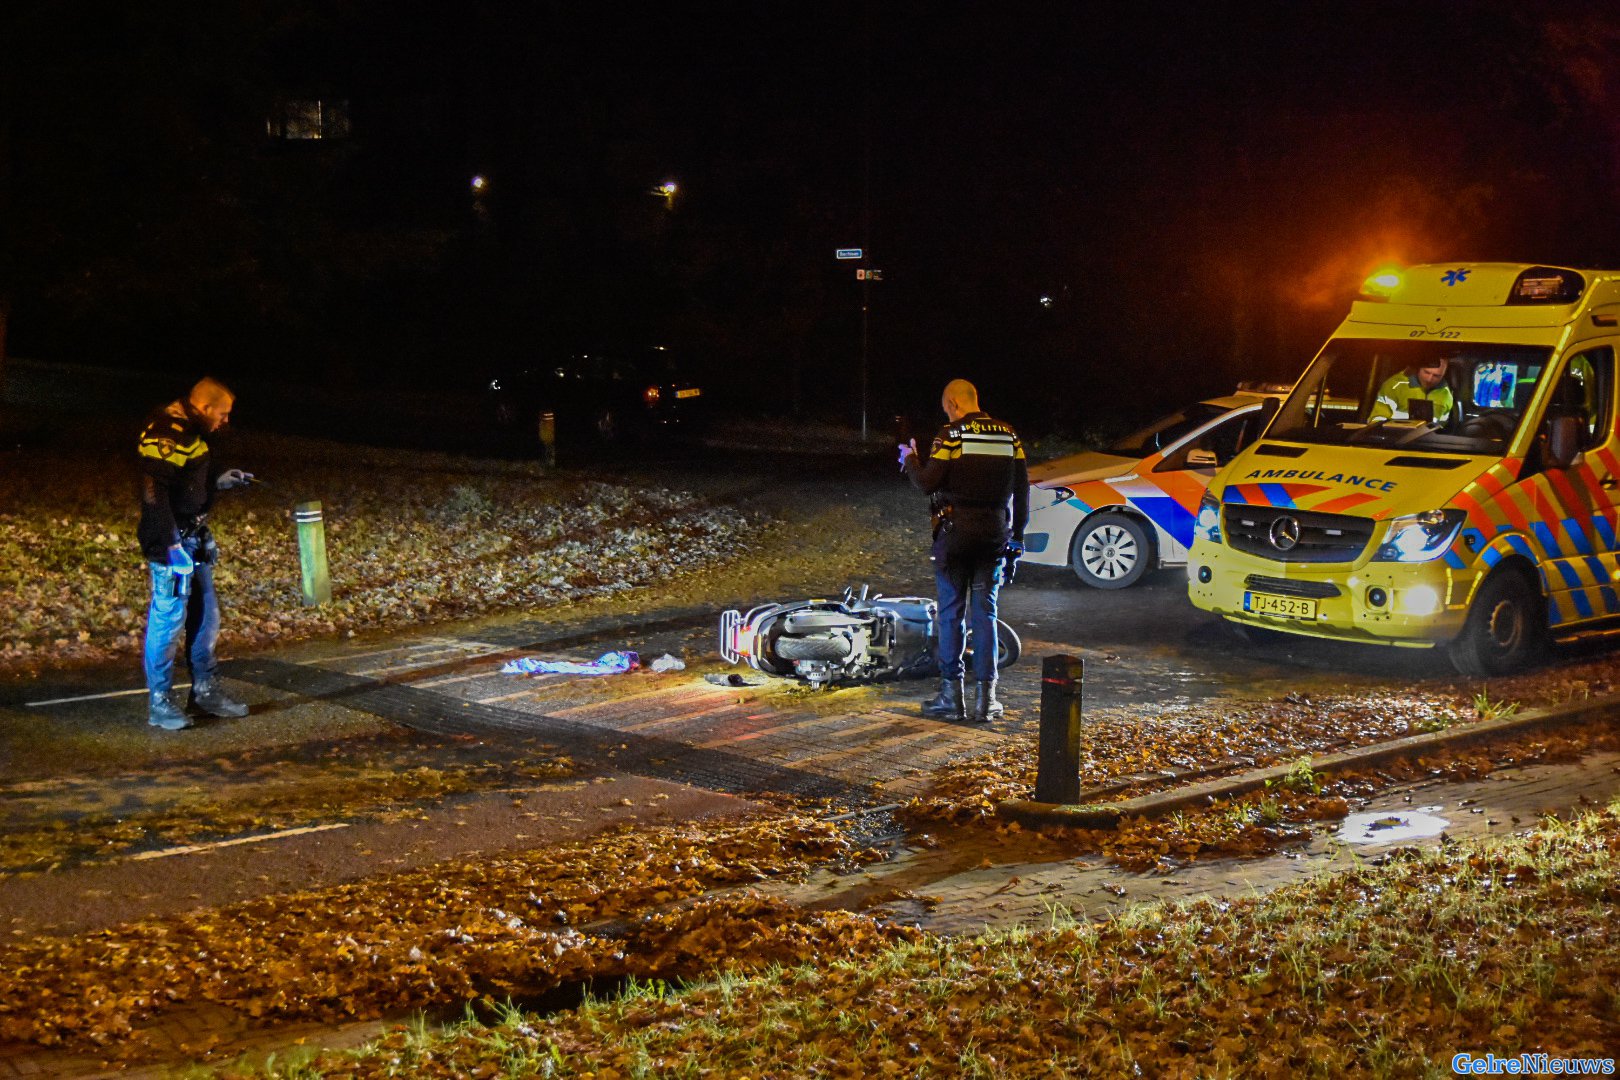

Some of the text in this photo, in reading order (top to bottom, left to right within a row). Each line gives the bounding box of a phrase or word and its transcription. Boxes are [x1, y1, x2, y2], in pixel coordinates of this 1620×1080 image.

[1409, 330, 1460, 339] 07 122
[1245, 469, 1398, 493] AMBULANCE
[1255, 596, 1309, 615] TJ-452-B
